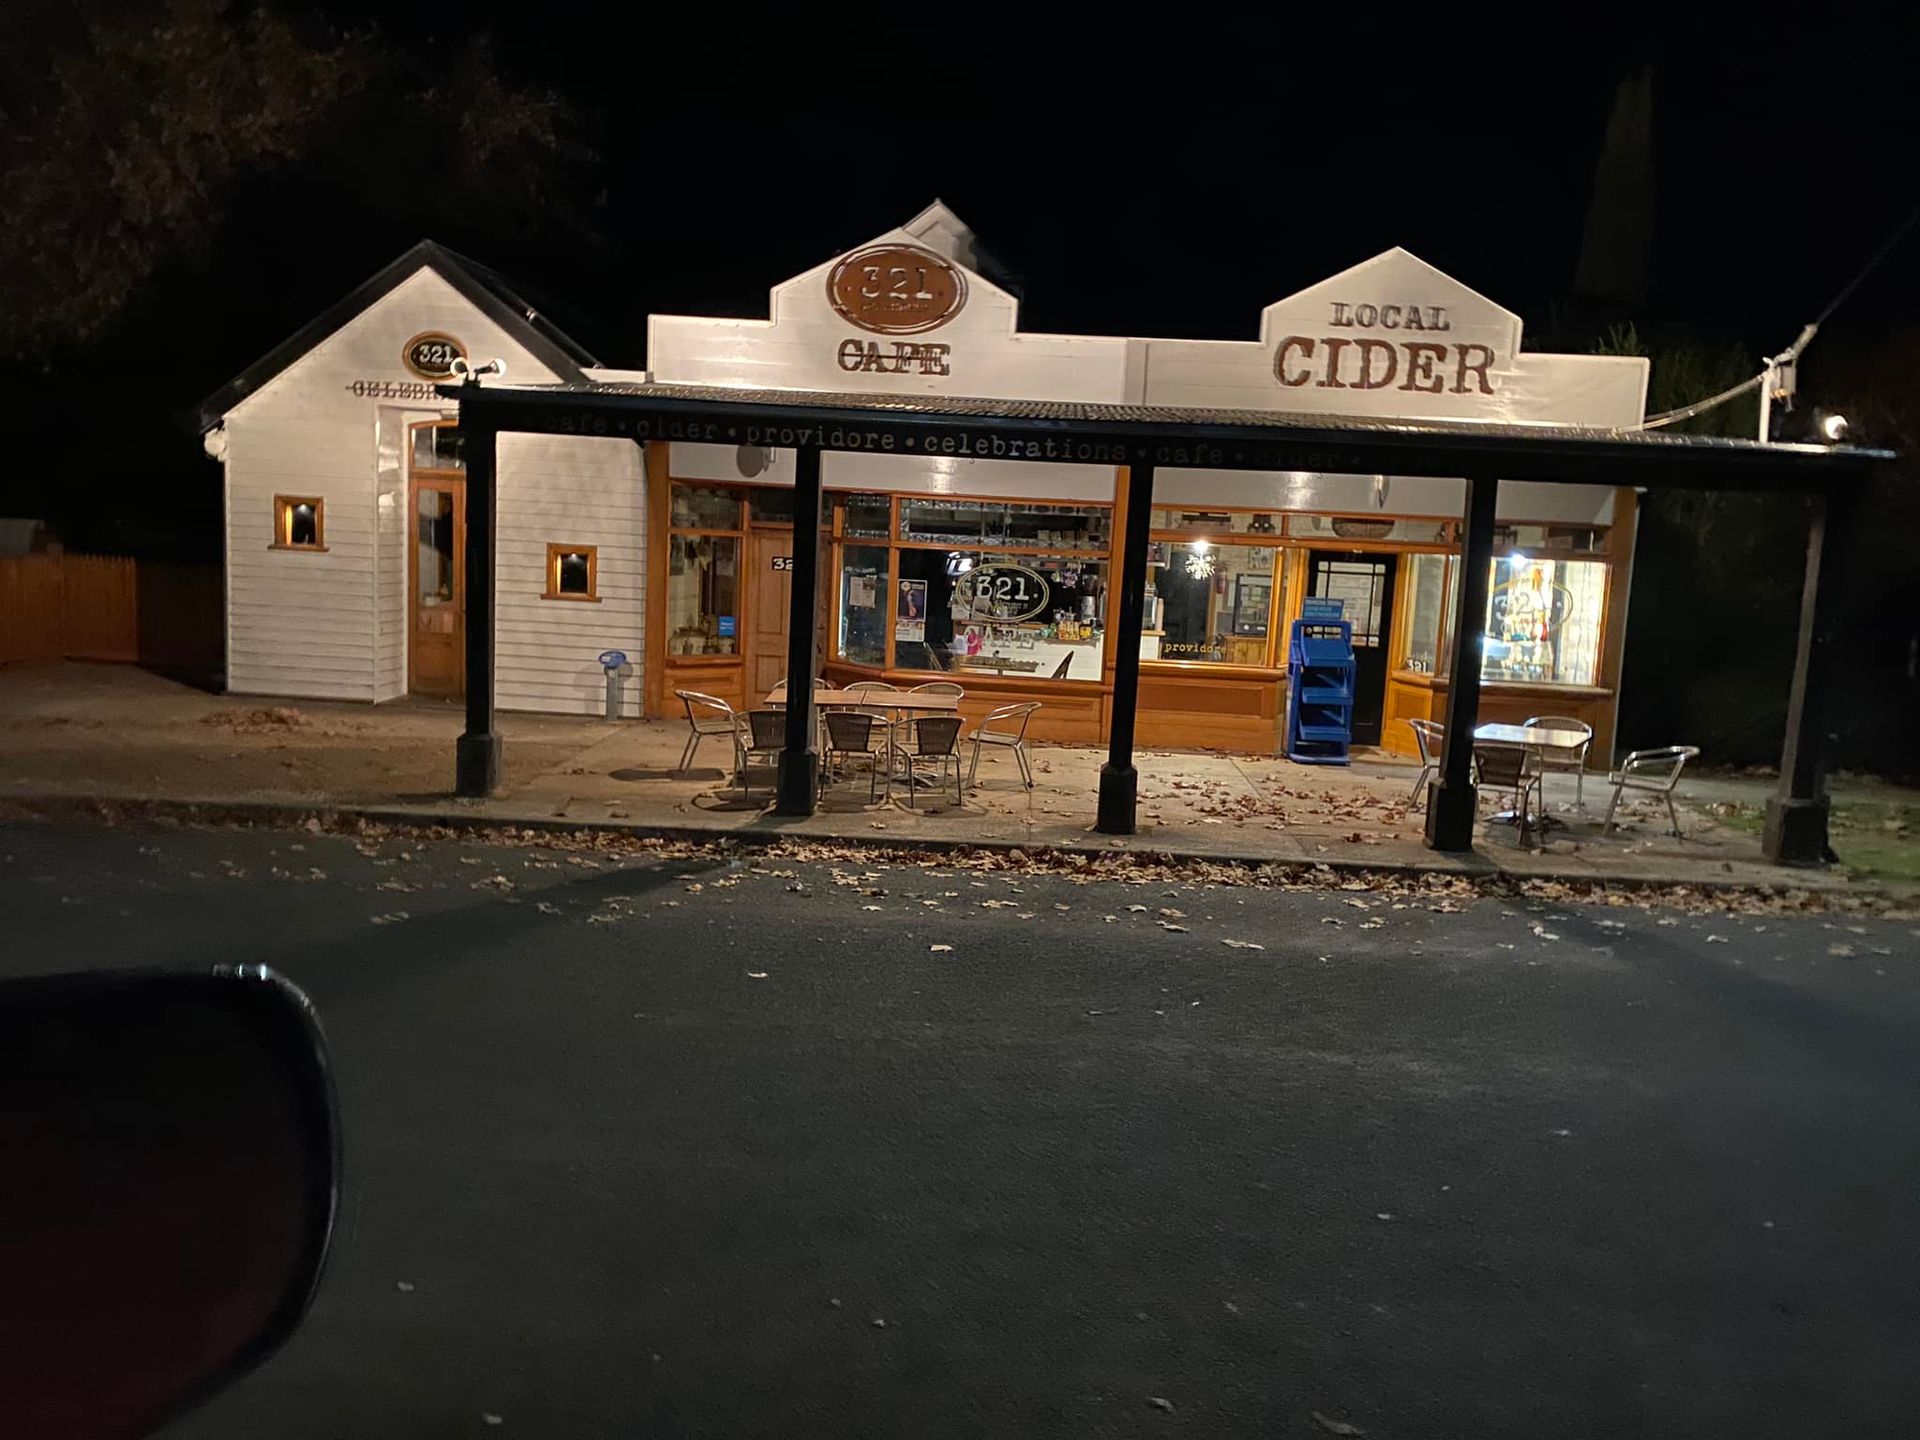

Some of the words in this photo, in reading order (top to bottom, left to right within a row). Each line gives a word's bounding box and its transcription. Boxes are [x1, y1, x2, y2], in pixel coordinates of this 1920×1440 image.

[860, 266, 934, 301] 321
[1329, 302, 1450, 331] LOCAL
[418, 344, 454, 364] 321
[837, 338, 952, 377] CAFE
[1273, 335, 1496, 395] CIDER
[745, 424, 896, 453] providore
[922, 433, 1128, 463] celebrations
[1155, 442, 1225, 465] cafe
[976, 575, 1031, 601] 321
